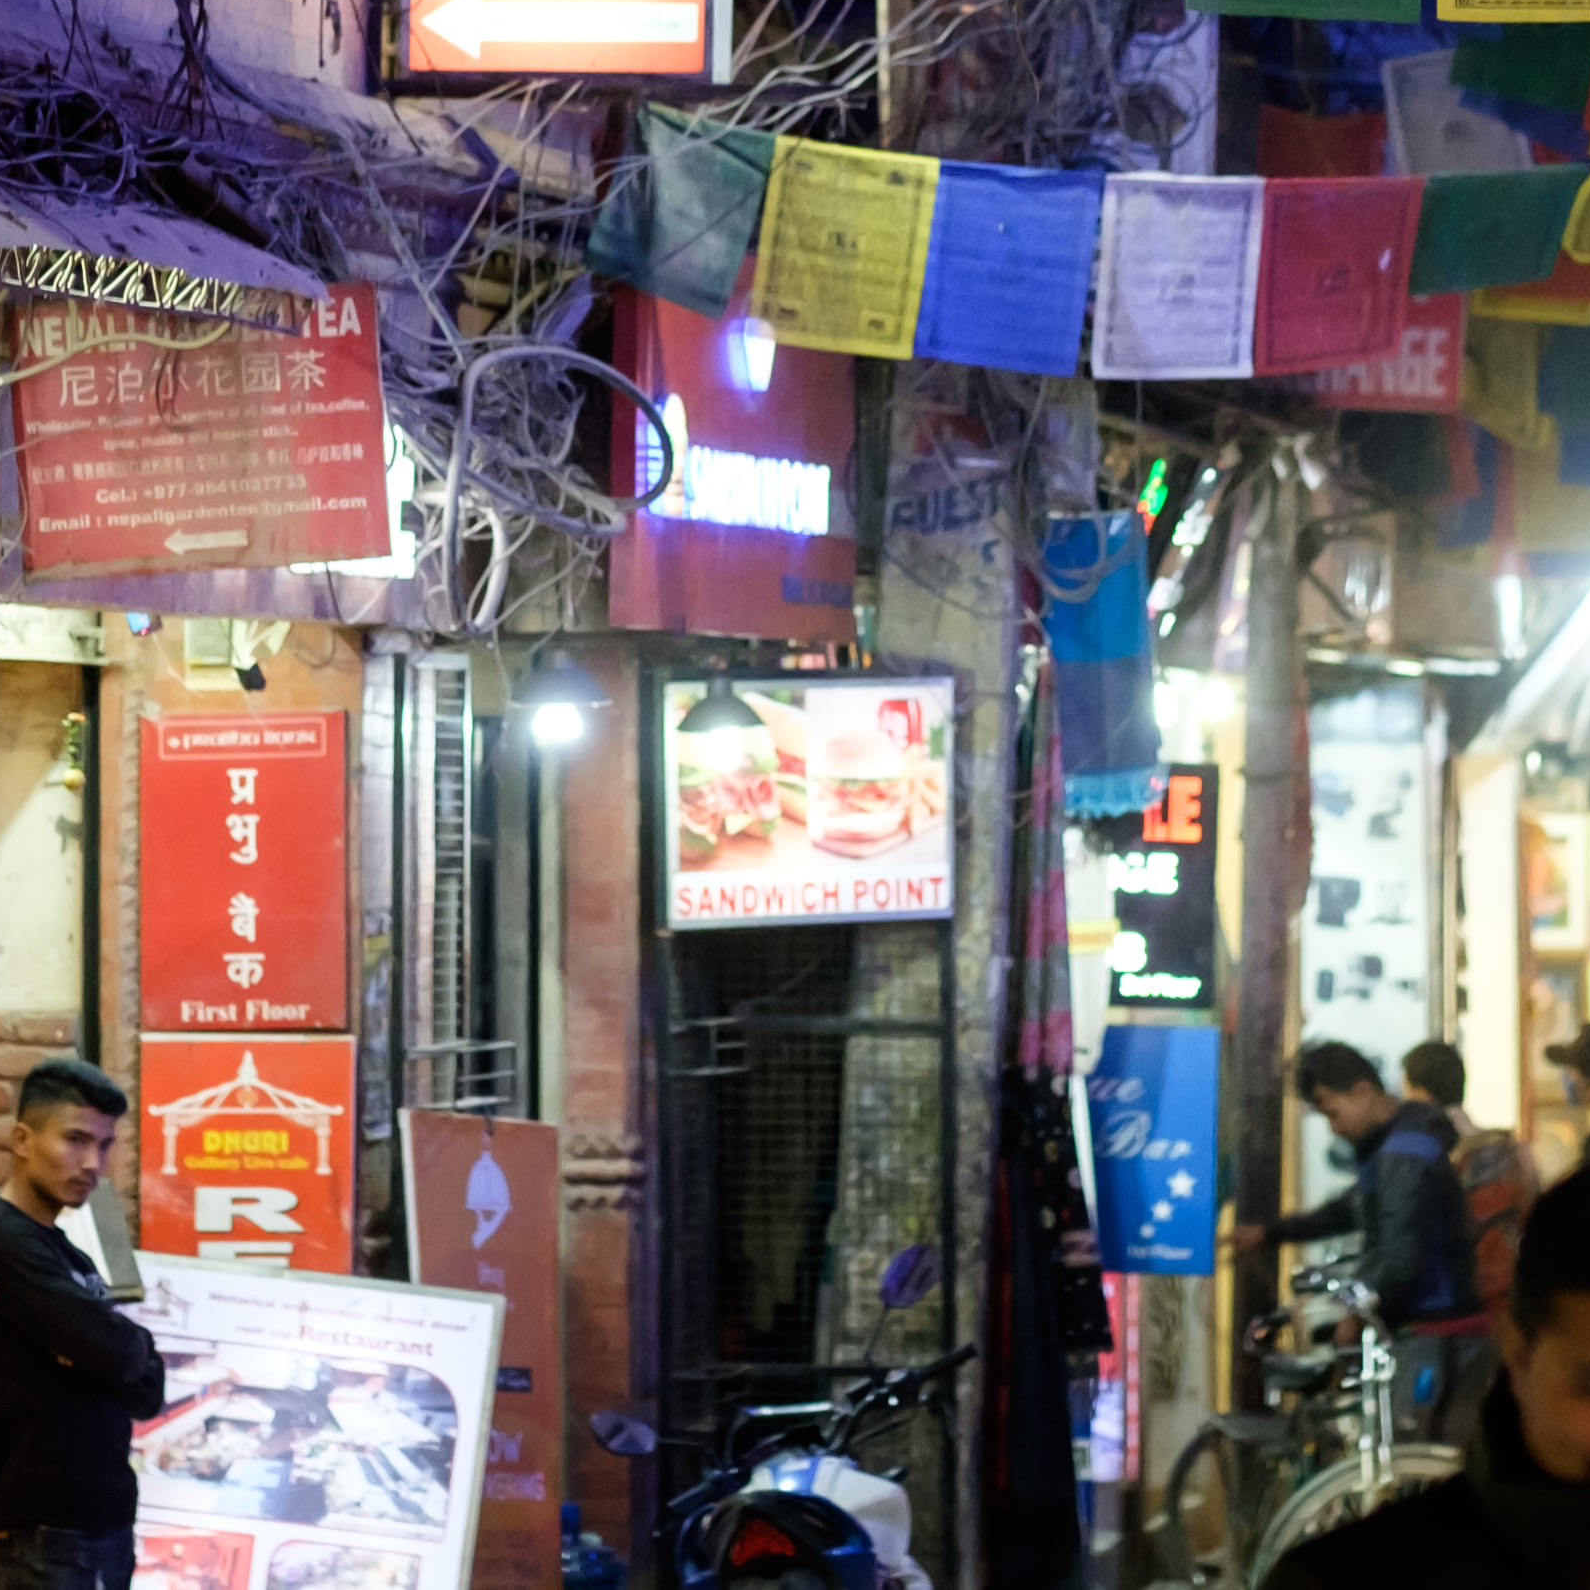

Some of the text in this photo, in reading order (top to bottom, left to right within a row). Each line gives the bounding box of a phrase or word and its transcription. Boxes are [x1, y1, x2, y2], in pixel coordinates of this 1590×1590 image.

[39, 514, 91, 533] Email
[677, 876, 944, 917] SANDWICH POINT
[180, 998, 312, 1023] First Floor
[1095, 1108, 1193, 1159] Bar
[298, 1322, 434, 1357] Restaurant
